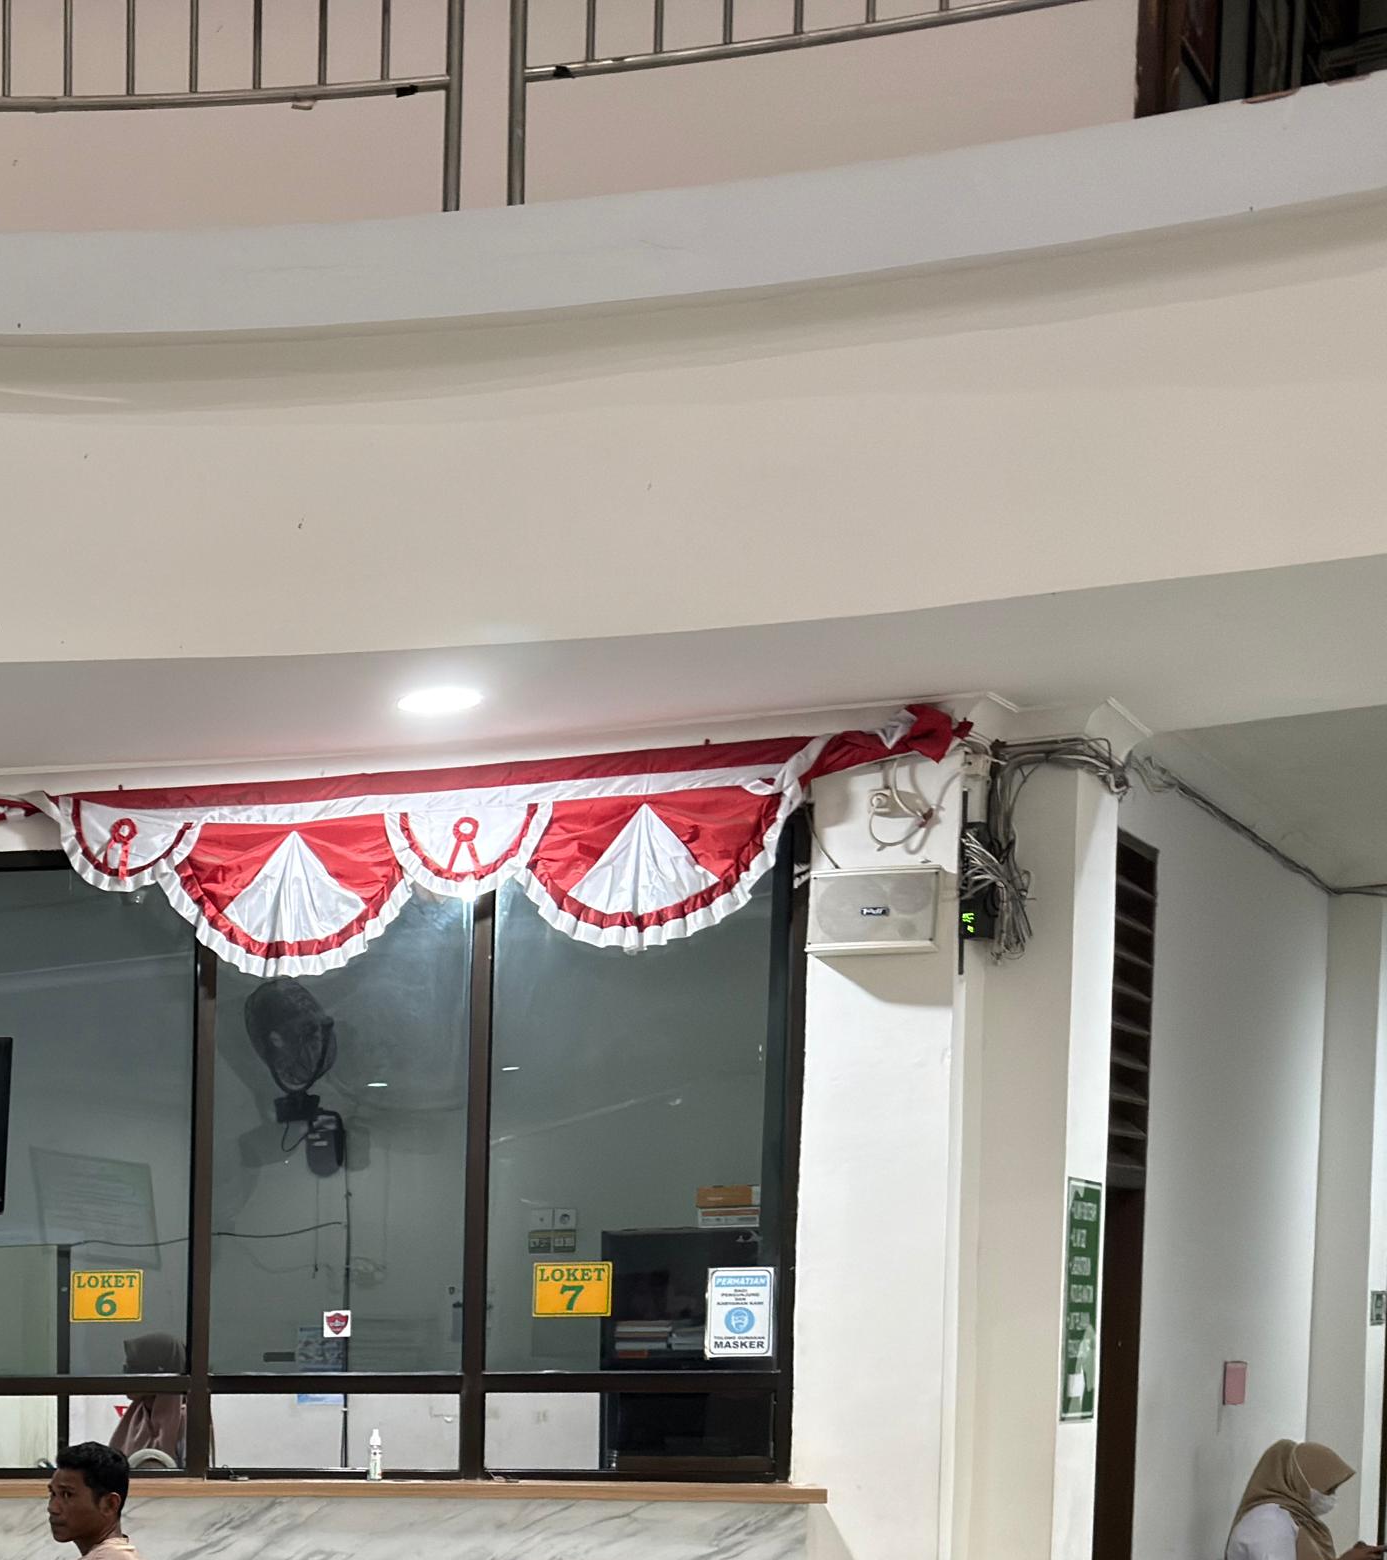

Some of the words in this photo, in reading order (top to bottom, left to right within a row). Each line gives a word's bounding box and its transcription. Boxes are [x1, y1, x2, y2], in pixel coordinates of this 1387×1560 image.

[539, 1268, 605, 1282] LOKET
[715, 1276, 767, 1286] PERHATIAN
[76, 1276, 137, 1288] LOKET
[96, 1291, 117, 1317] 6
[560, 1286, 584, 1311] 7
[714, 1340, 765, 1349] MASKER
